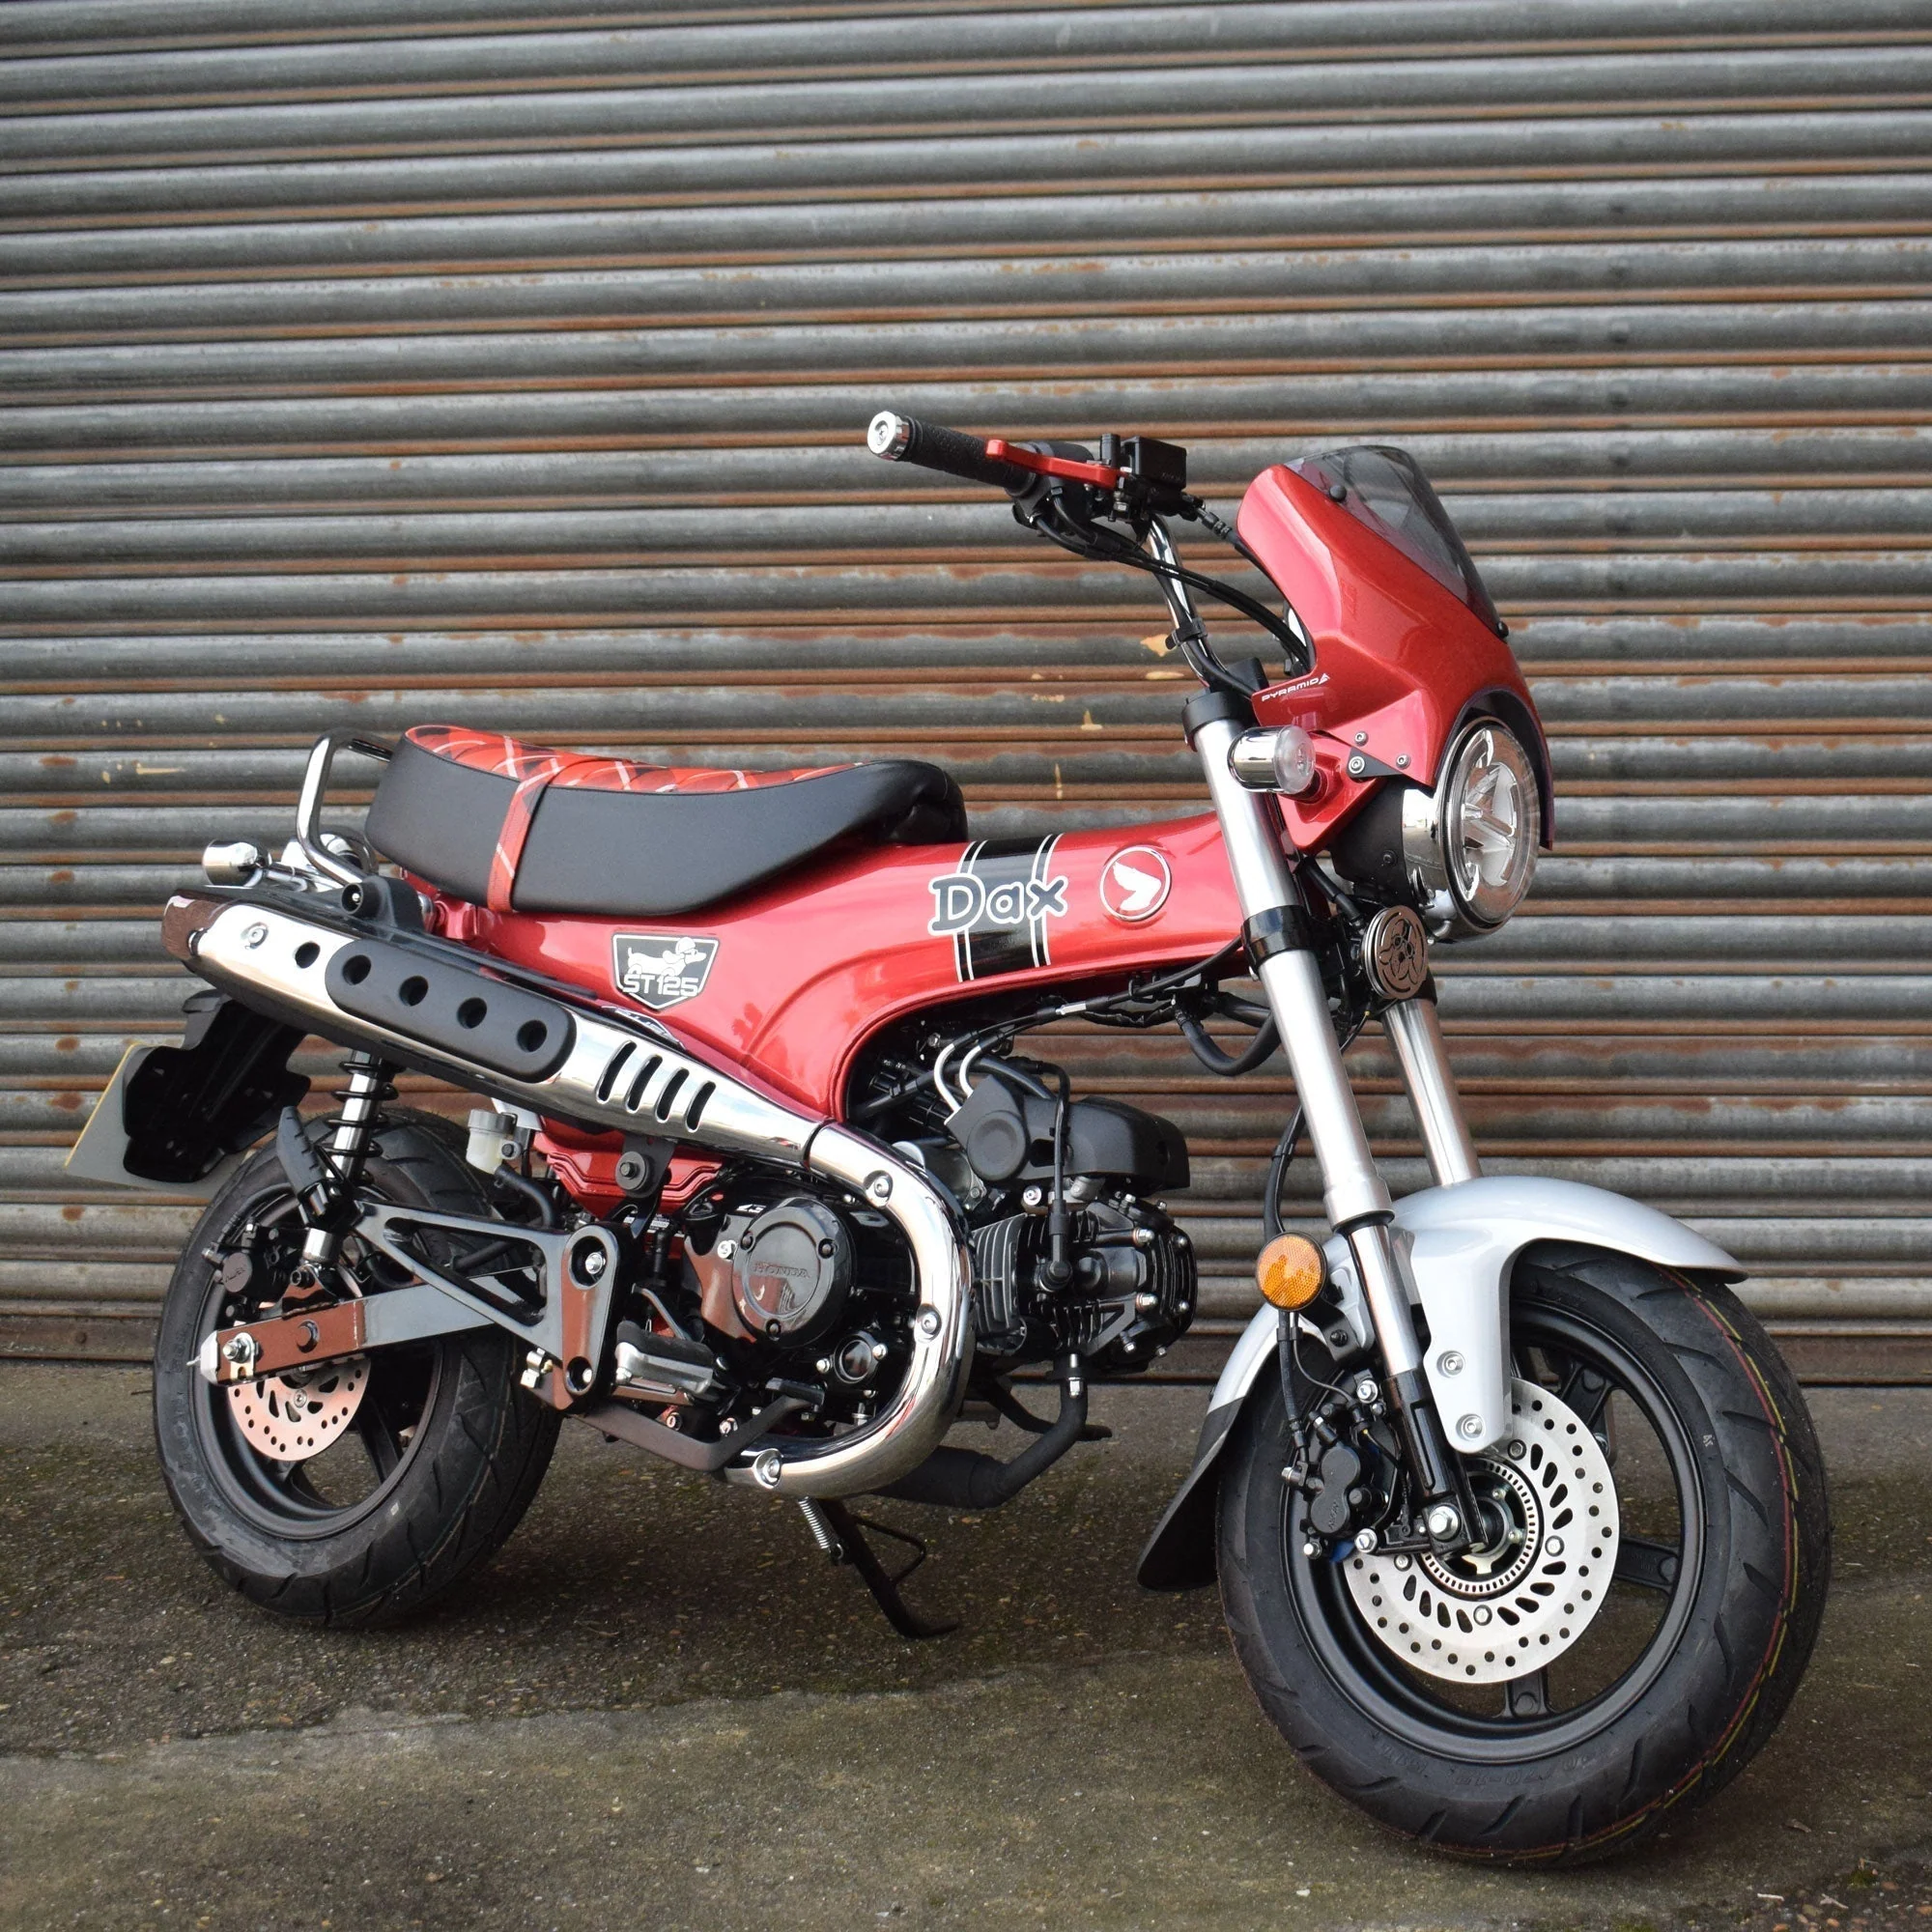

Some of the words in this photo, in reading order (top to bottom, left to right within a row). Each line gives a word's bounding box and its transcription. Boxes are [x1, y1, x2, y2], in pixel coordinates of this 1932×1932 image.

[1262, 677, 1320, 702] PYRAMID
[927, 873, 1068, 935] Dax
[622, 973, 699, 998] ST125
